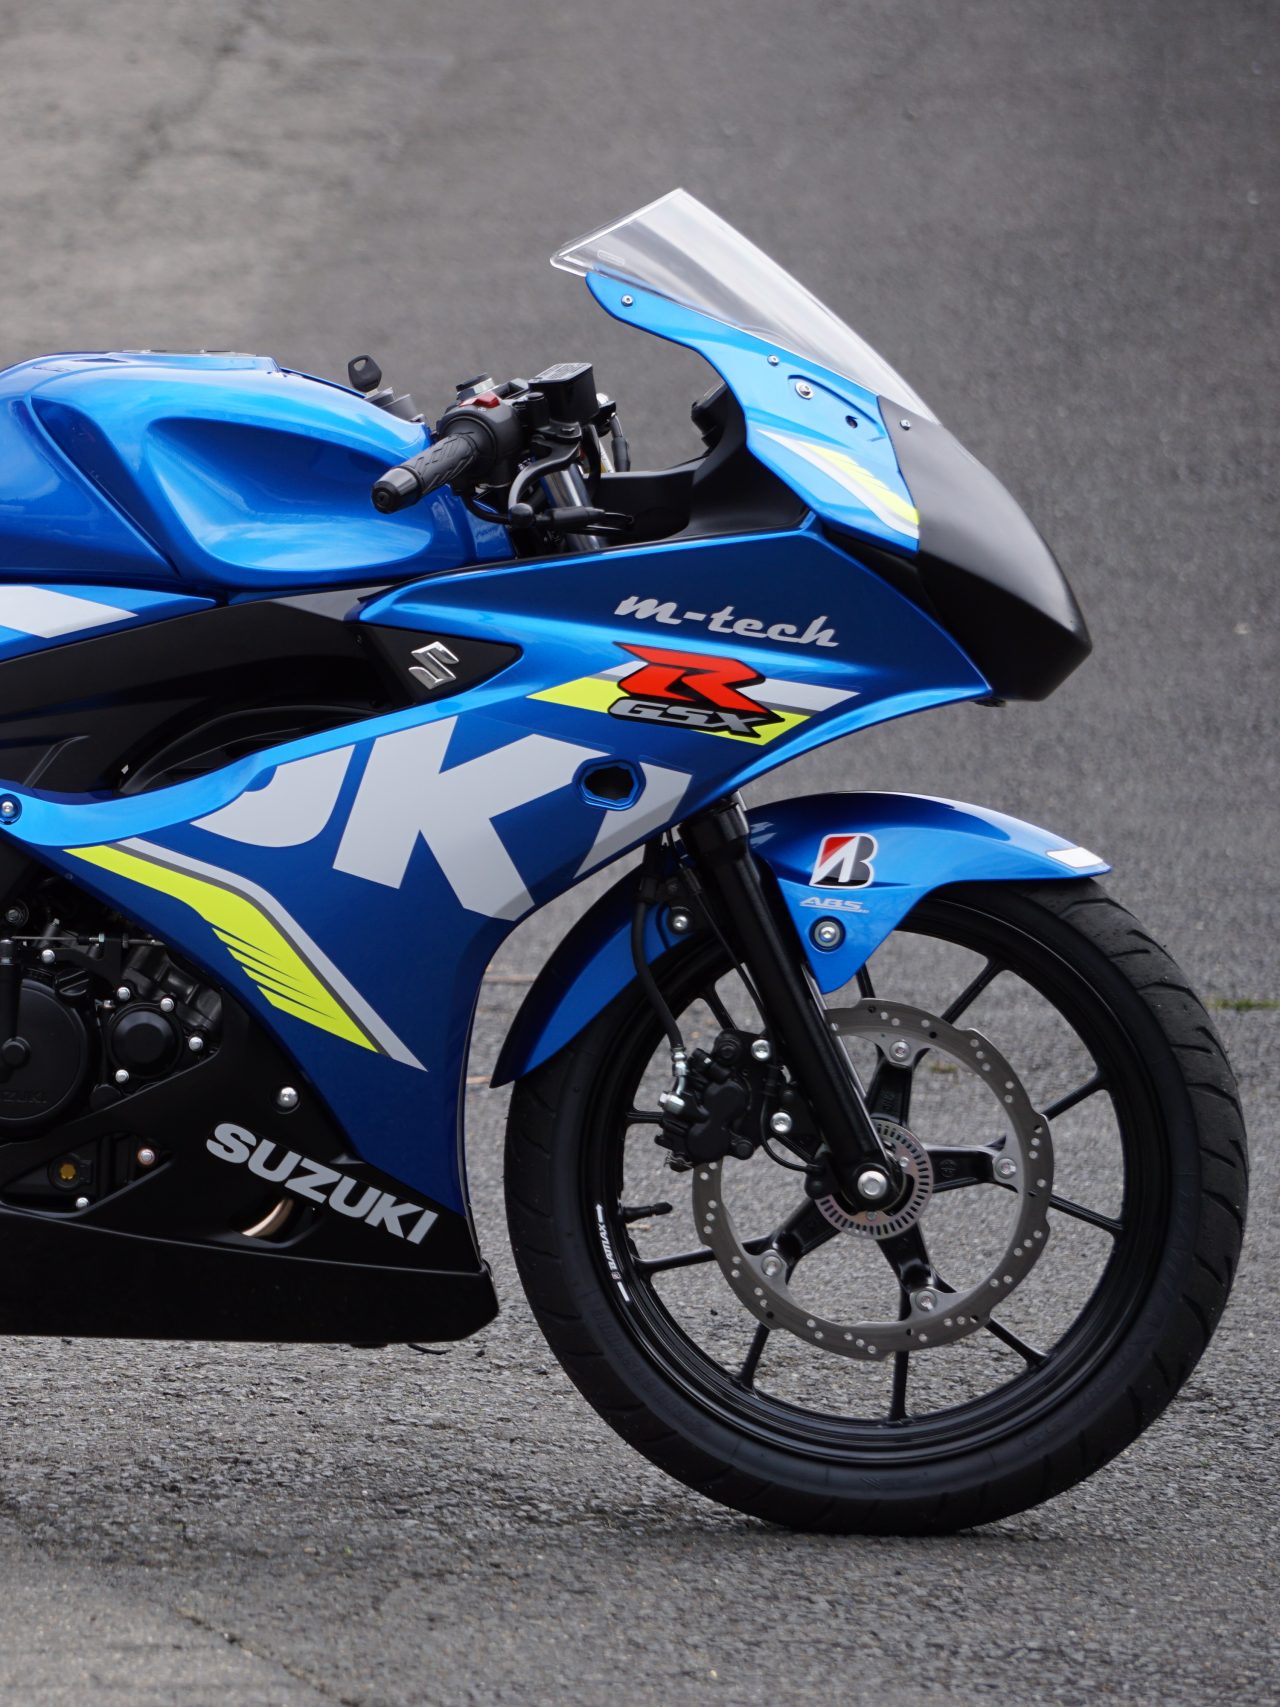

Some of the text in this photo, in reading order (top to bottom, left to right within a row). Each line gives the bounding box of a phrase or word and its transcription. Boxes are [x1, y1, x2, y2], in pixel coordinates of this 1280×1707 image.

[614, 595, 839, 648] m-tech
[613, 642, 772, 715] R
[608, 698, 769, 734] GSX
[800, 896, 865, 912] ABS
[206, 1122, 439, 1245] SUZUKI
